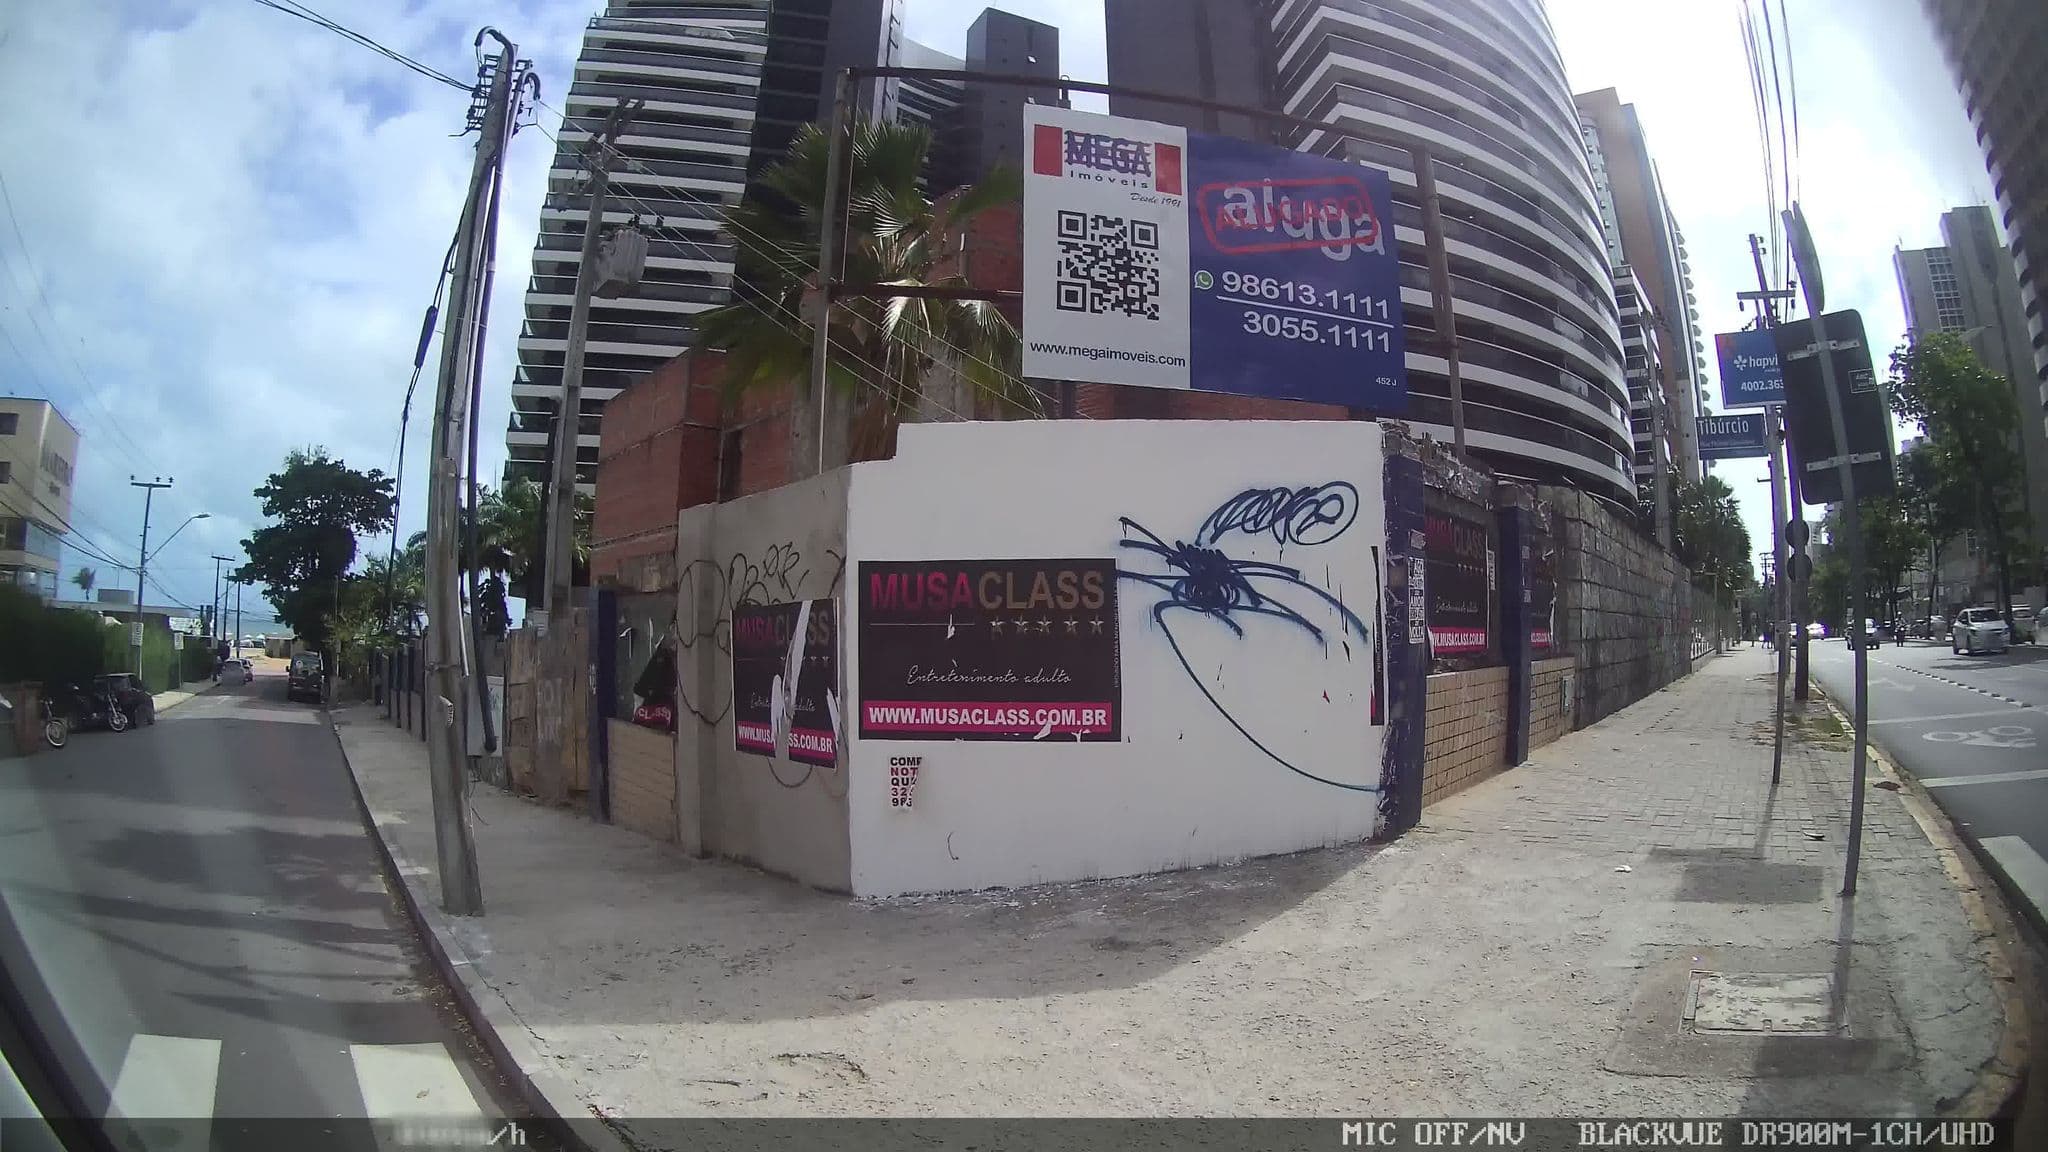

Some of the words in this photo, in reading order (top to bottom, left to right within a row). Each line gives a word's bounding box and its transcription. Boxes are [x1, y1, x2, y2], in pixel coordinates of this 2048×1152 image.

[1064, 130, 1152, 177] MEGA
[1160, 195, 1181, 208] 1991
[1223, 178, 1385, 261] aluga
[1222, 270, 1389, 320] 98613.1111
[1243, 310, 1390, 353] 3055.1111
[1030, 342, 1186, 367] www.megaimoveis.com
[1697, 417, 1749, 436] Tibúrcio
[906, 663, 1019, 686] Entretenimento
[1023, 667, 1073, 684] adulto
[869, 706, 1107, 726] WWW.MUSACLASS.COM.BR
